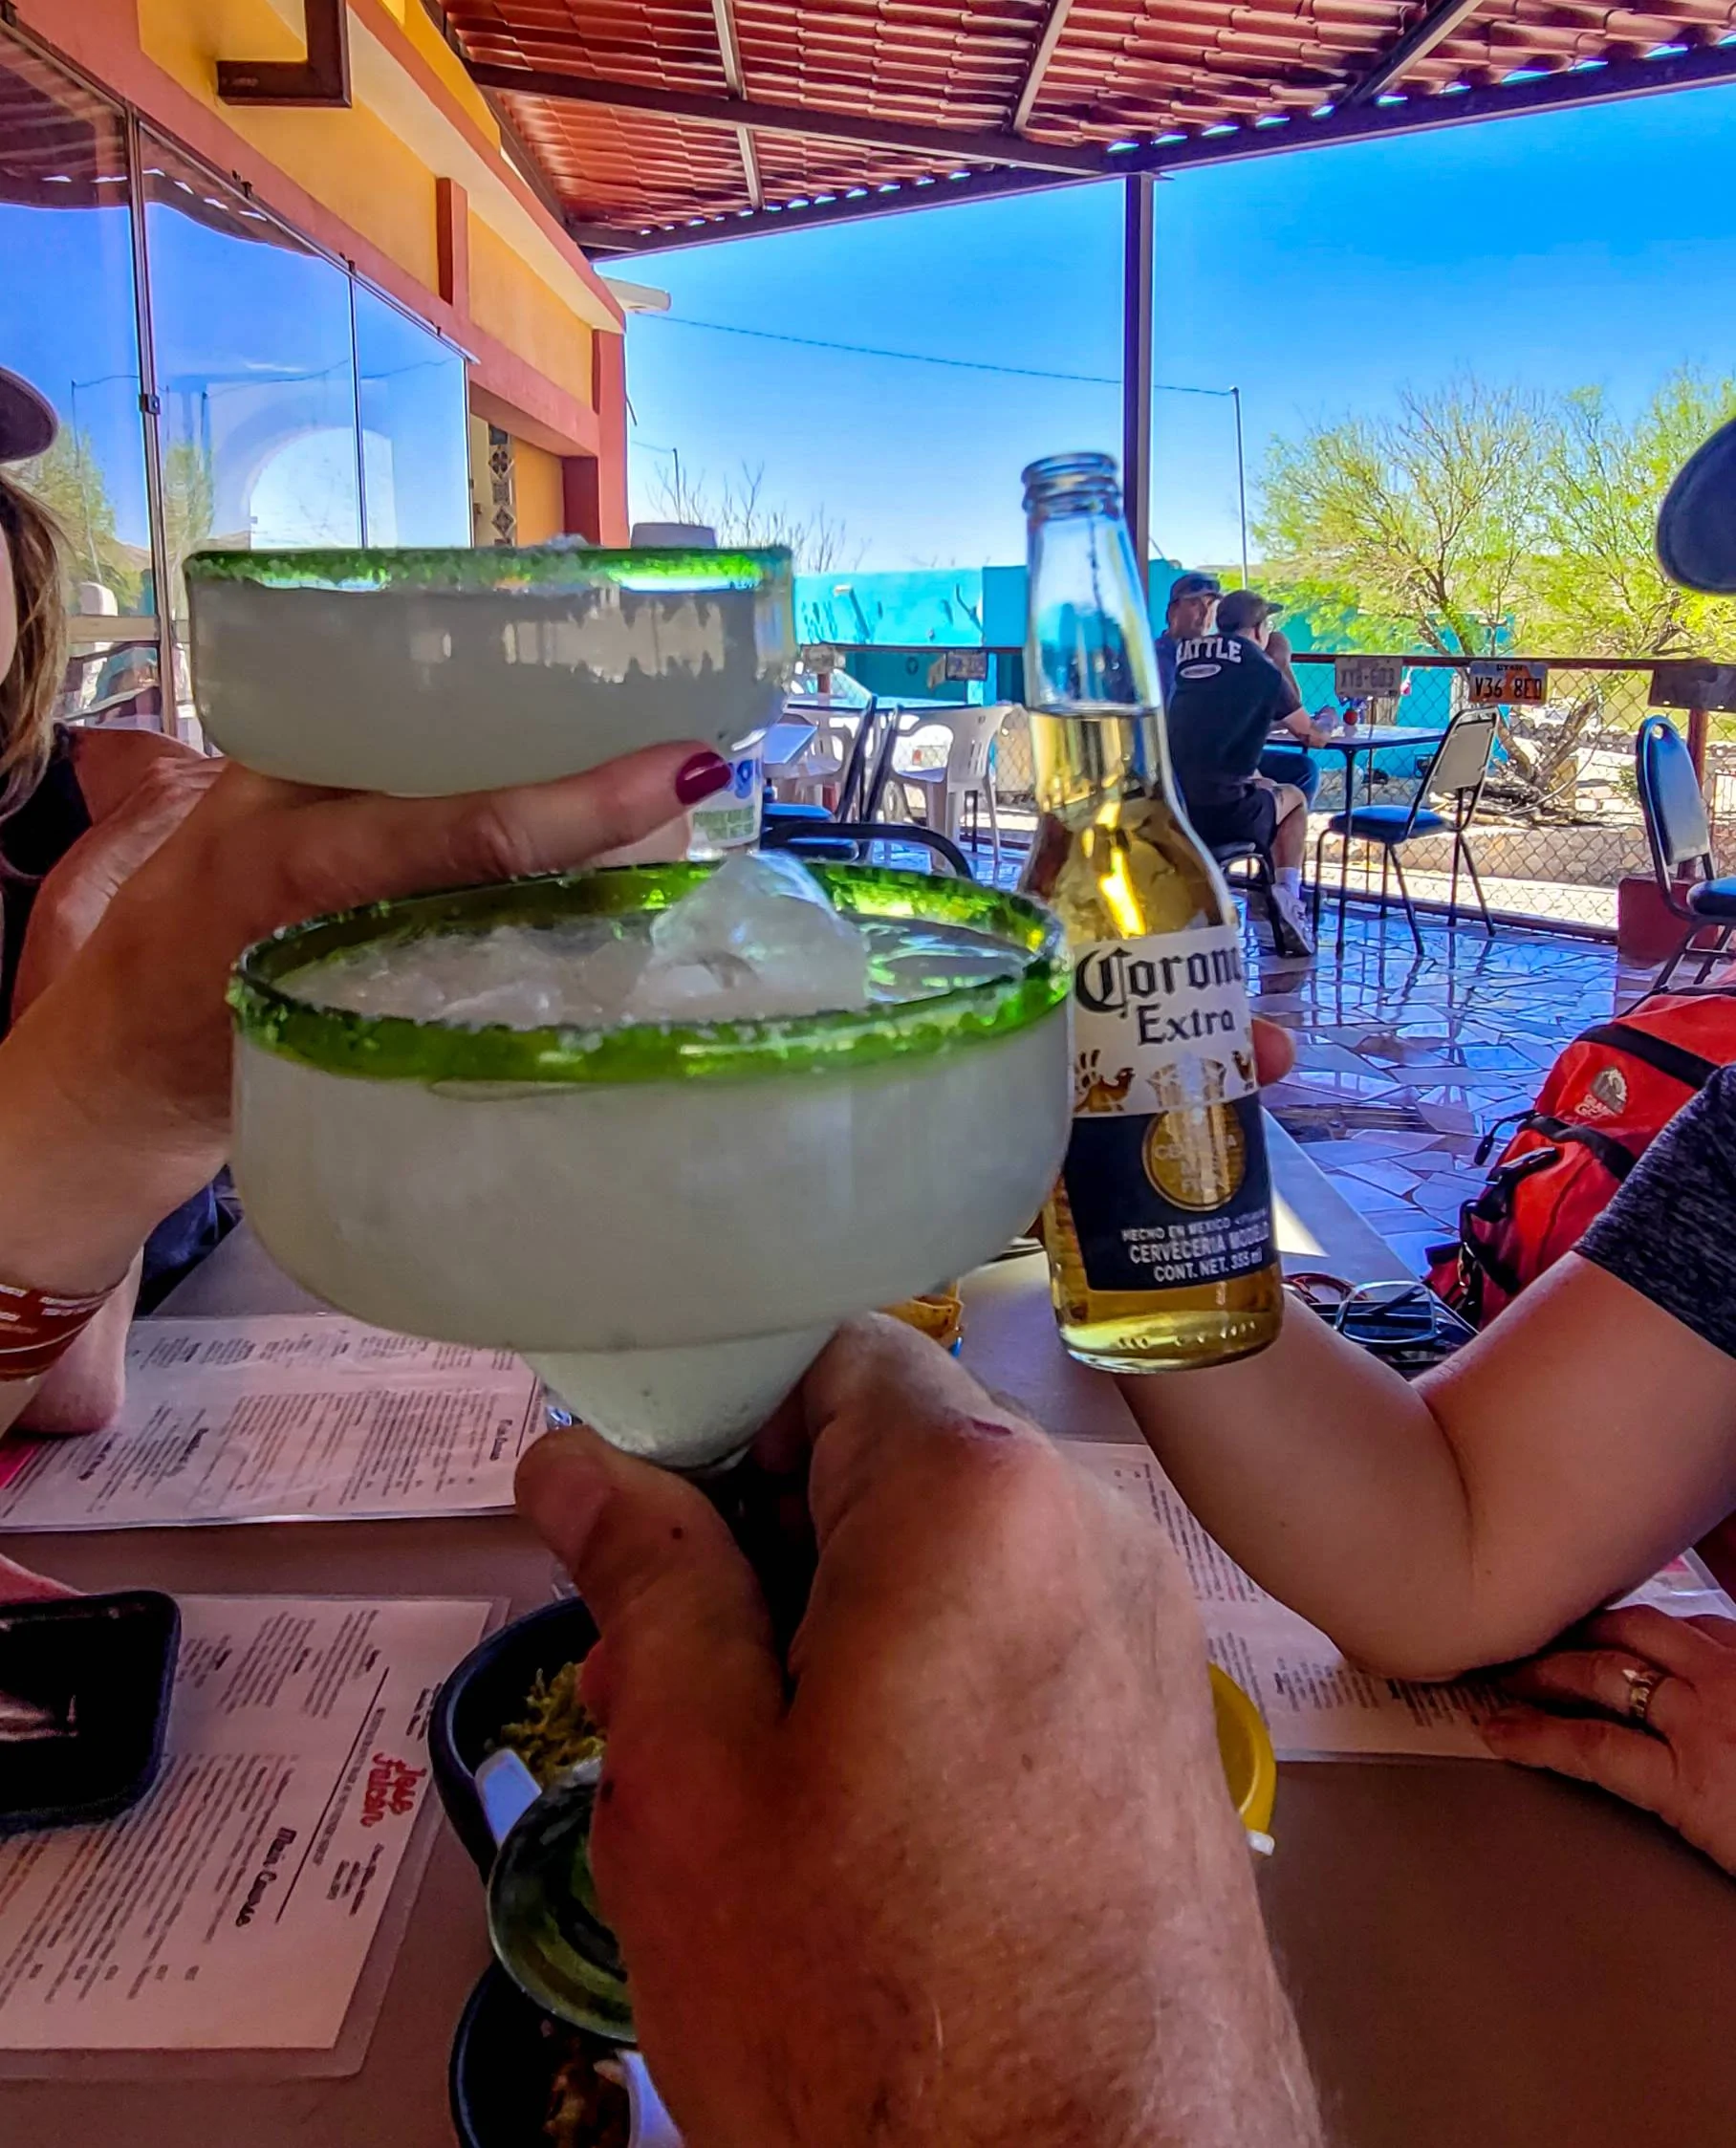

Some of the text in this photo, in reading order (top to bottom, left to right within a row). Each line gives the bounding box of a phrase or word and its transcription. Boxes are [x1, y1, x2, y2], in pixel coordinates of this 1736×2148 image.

[1137, 1004, 1235, 1046] Extra
[1121, 1227, 1165, 1242] HECHO
[1154, 1262, 1197, 1283] CONT.
[1199, 1256, 1229, 1276] NET.
